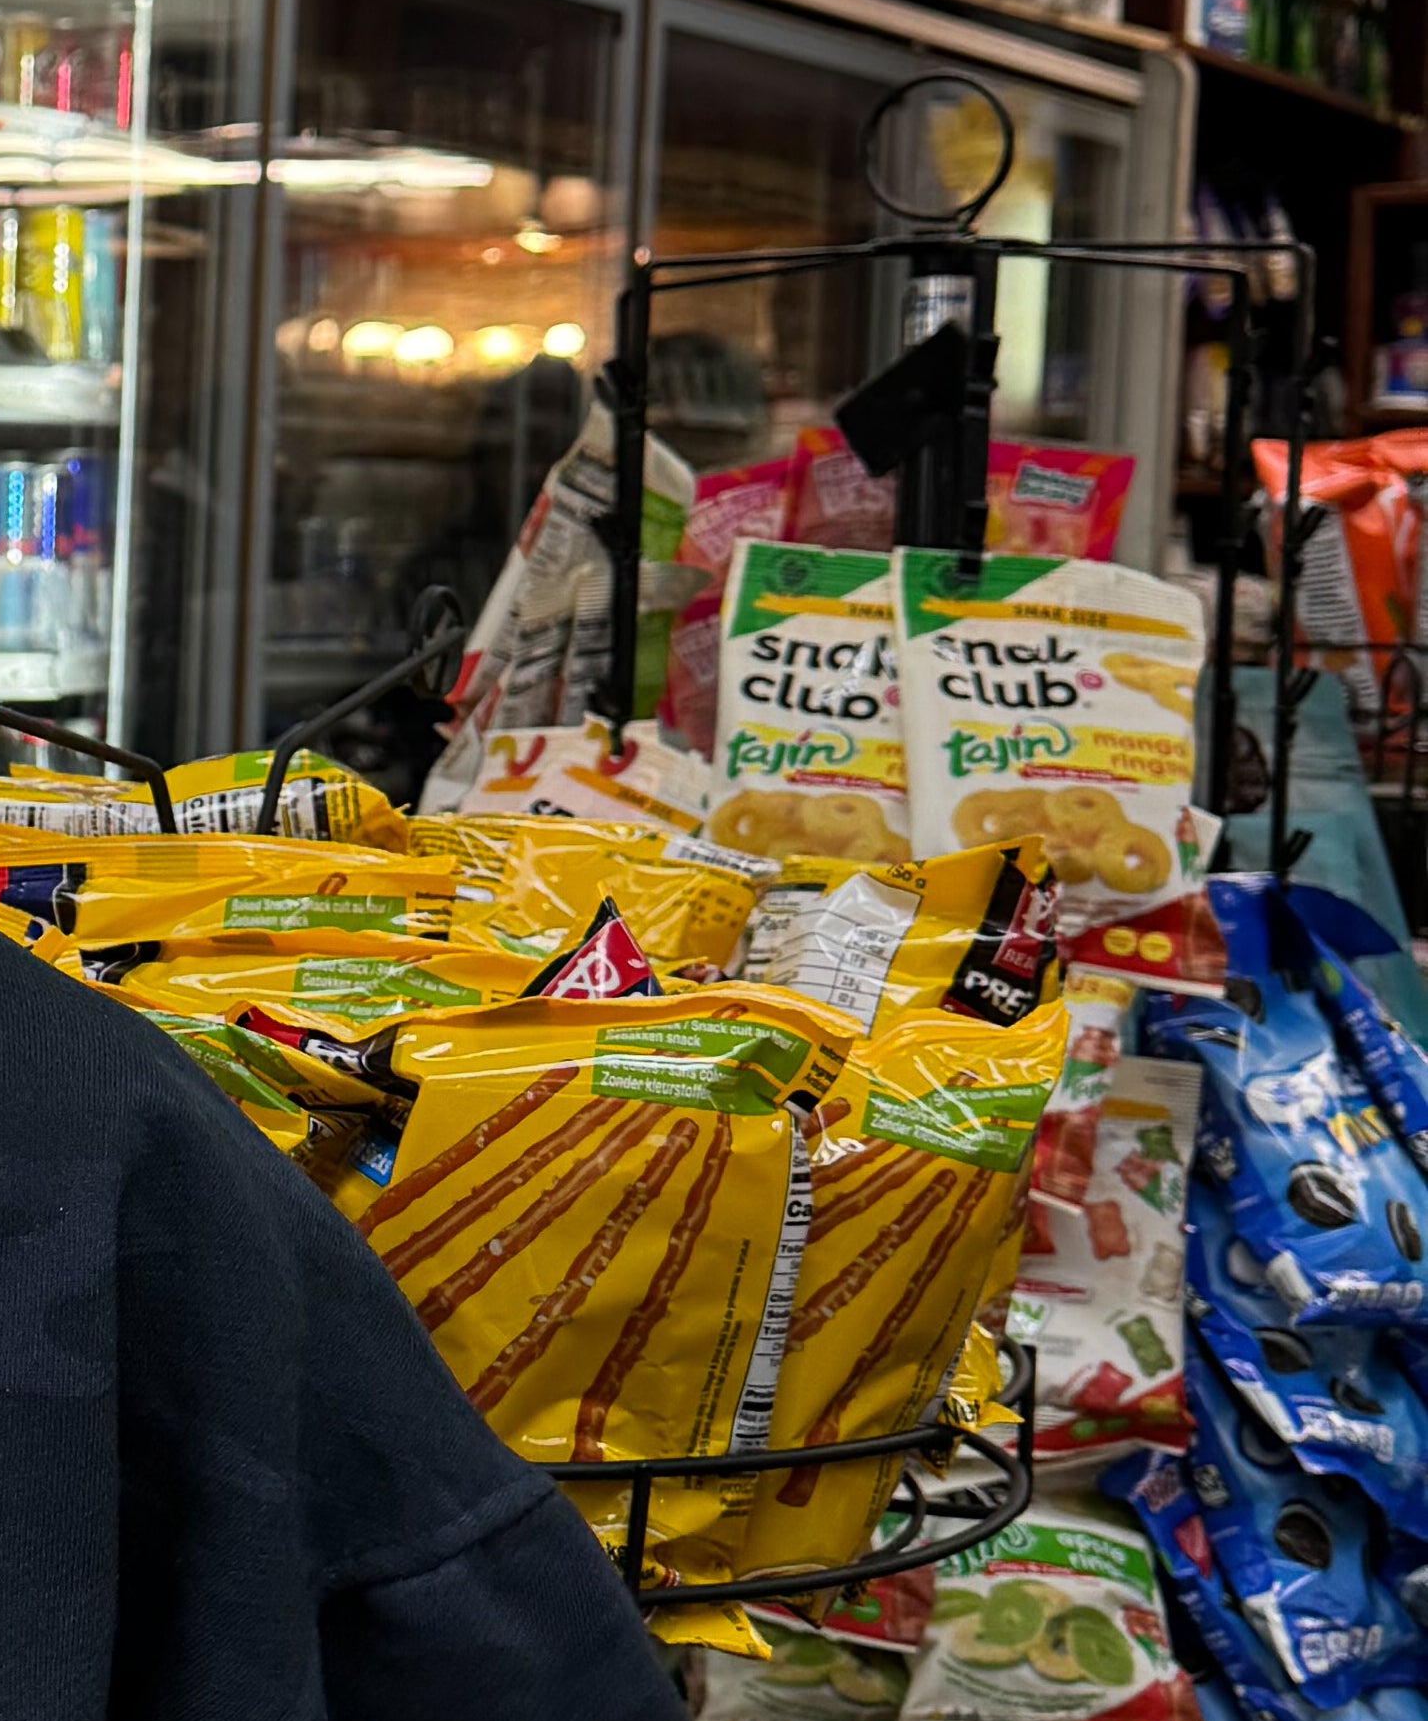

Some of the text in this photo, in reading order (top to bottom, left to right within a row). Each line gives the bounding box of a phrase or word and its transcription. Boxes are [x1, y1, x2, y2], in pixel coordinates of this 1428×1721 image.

[741, 672, 880, 721] club
[939, 671, 1078, 710] club
[666, 1033, 702, 1048] snack
[690, 1020, 727, 1034] Snack
[730, 1022, 753, 1036] cuit
[601, 1070, 642, 1091] Zonder
[1056, 1531, 1127, 1563] apple
